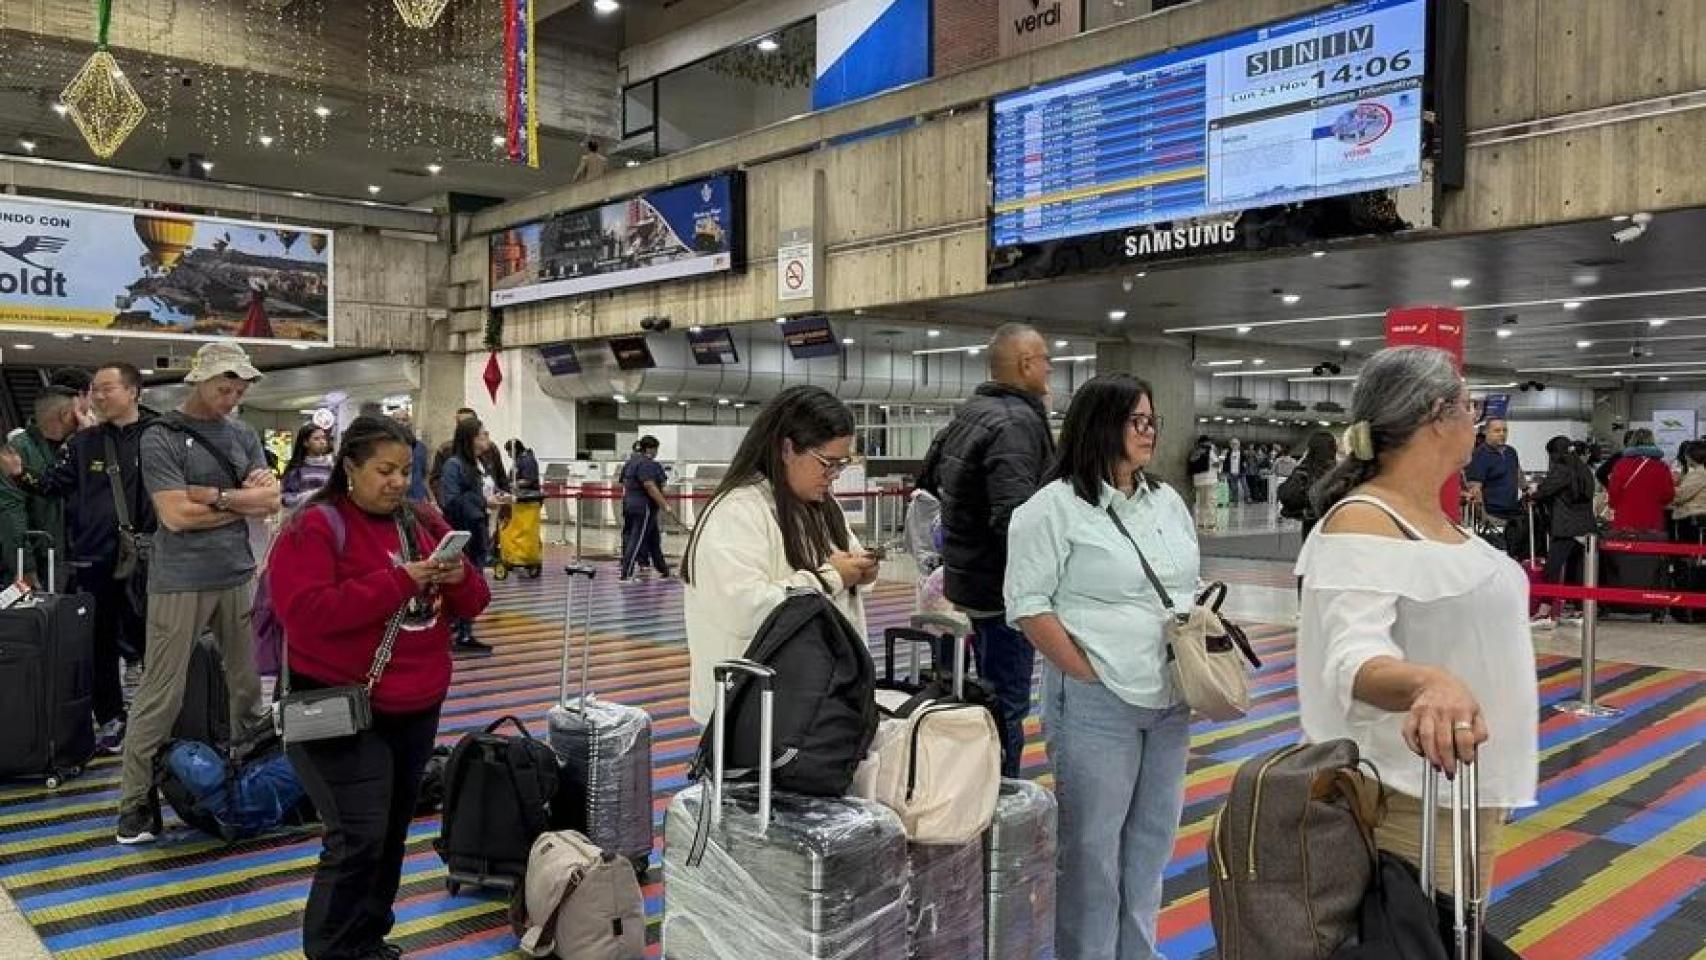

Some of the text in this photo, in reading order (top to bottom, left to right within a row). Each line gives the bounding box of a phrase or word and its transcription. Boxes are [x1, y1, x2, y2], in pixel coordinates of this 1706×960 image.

[1248, 25, 1373, 77] SINIV
[1279, 80, 1309, 93] Nov
[1311, 49, 1412, 88] 14:06
[0, 212, 70, 228] NDO CON
[1125, 222, 1235, 257] SAMSUNG
[0, 268, 67, 297] oldt
